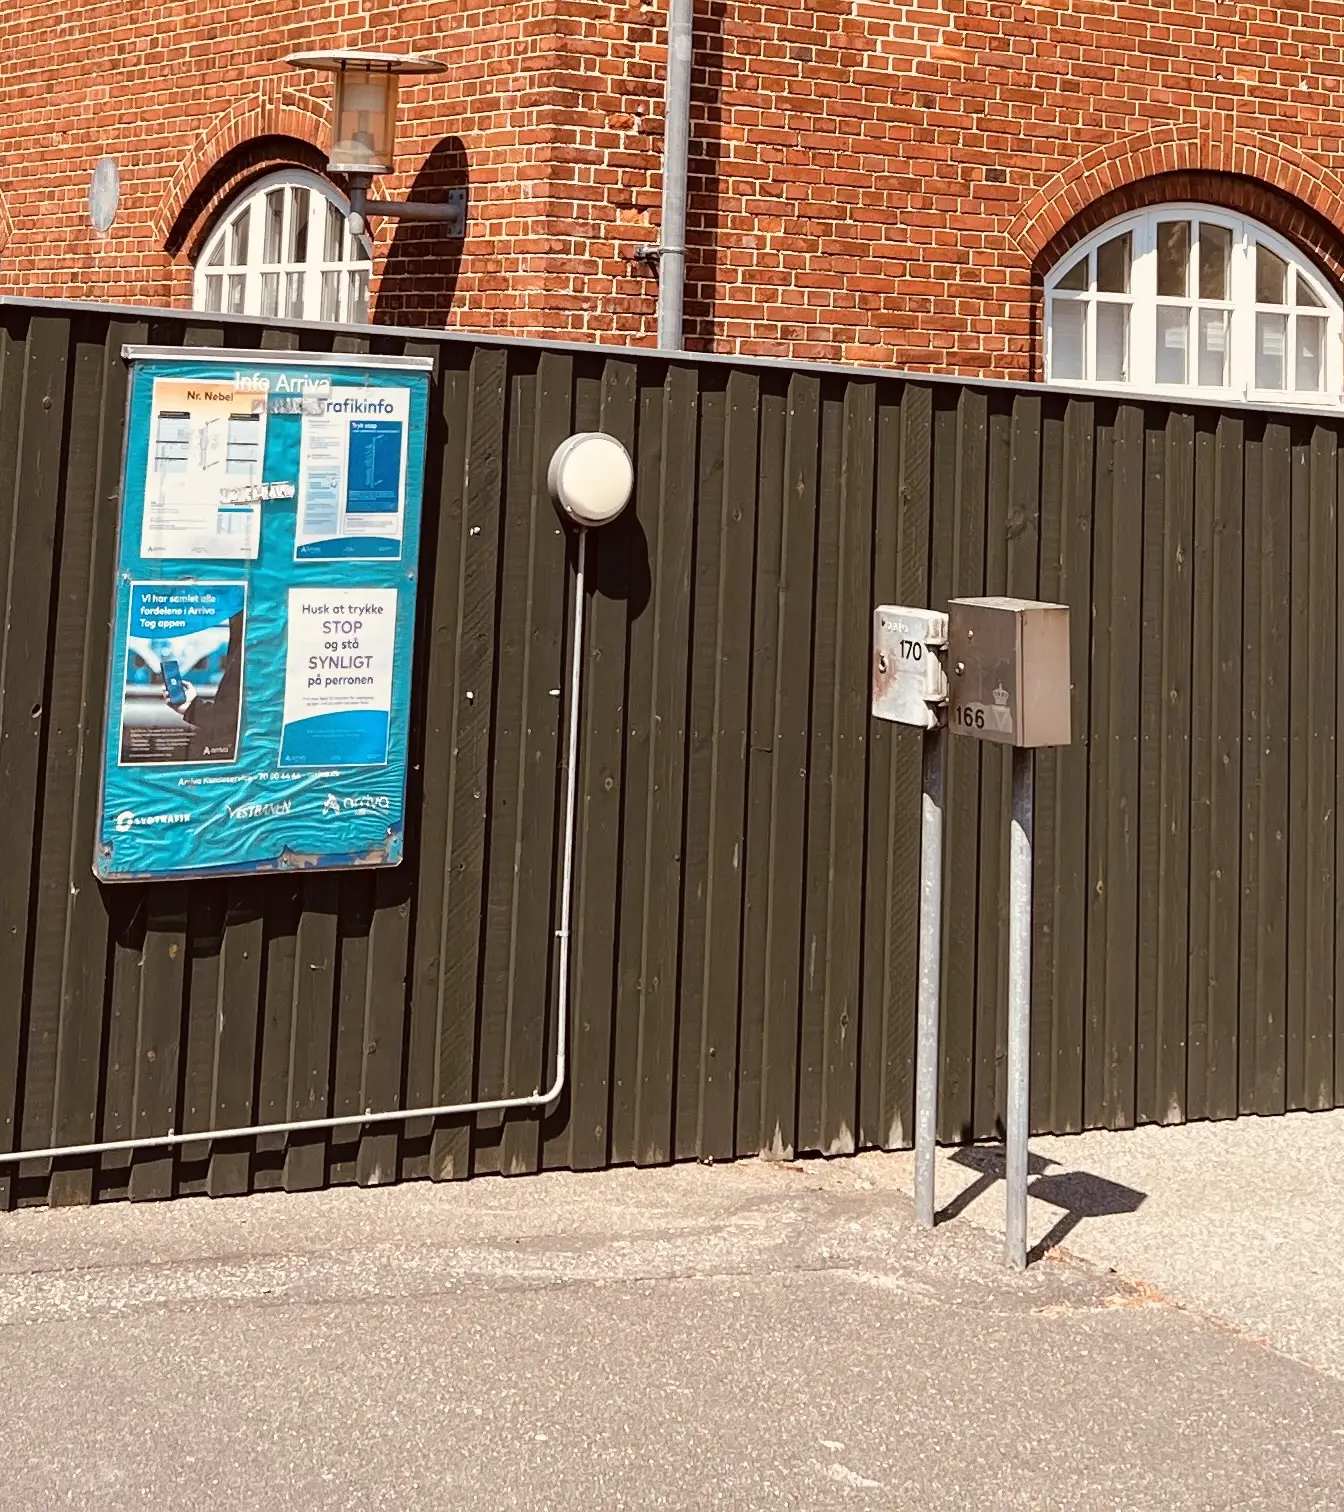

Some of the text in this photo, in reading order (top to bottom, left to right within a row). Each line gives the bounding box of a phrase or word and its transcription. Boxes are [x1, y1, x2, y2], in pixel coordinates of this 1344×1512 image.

[234, 372, 331, 392] Info Arriva
[187, 391, 234, 402] Nr. Nebel
[152, 594, 167, 603] har
[140, 606, 183, 616] fordelene
[188, 606, 216, 615] Arriva
[302, 604, 384, 616] Husk at trykke
[140, 619, 186, 630] Tag appen
[322, 620, 363, 634] STOP
[324, 637, 359, 652] og stå
[899, 639, 922, 661] 170
[308, 655, 374, 669] SYNLIGT
[308, 673, 374, 688] på perronen
[956, 706, 985, 729] 166
